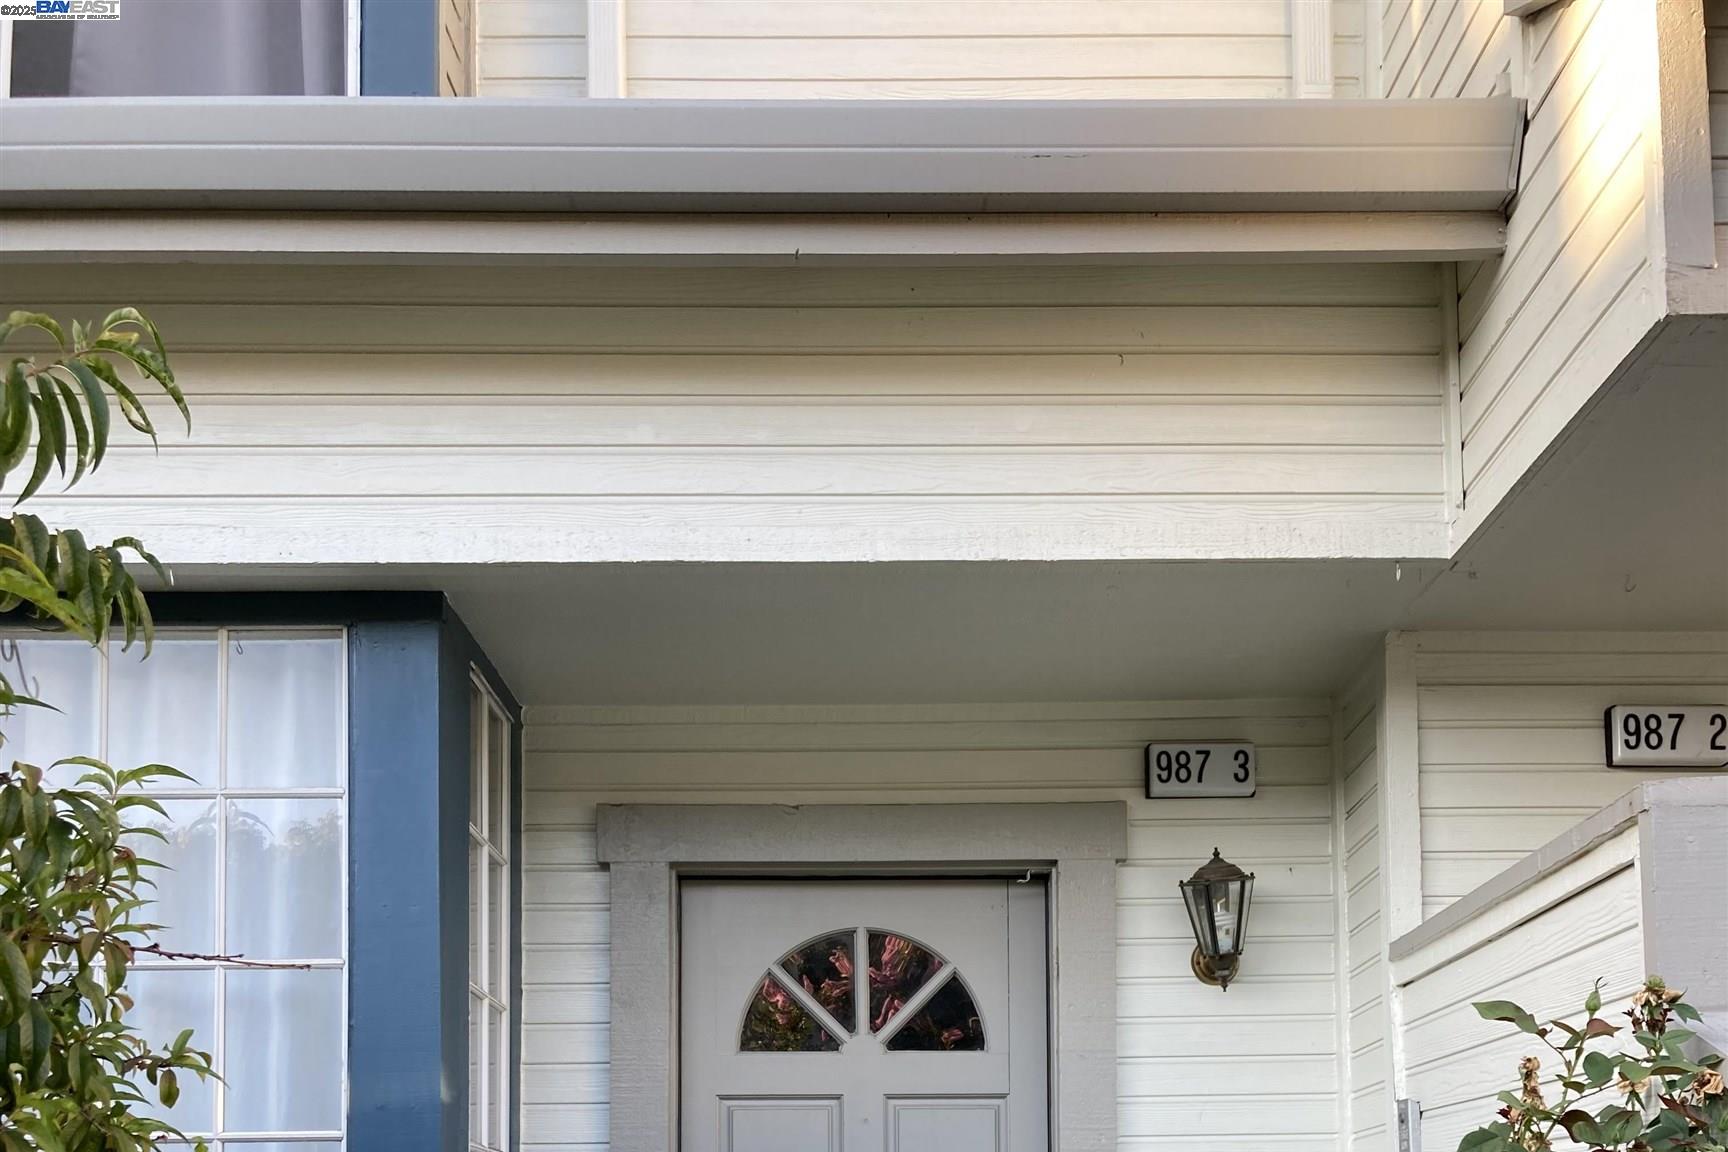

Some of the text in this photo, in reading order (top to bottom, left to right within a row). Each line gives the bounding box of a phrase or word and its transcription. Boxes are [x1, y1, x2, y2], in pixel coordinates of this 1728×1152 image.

[1623, 713, 1727, 751] 987 2
[1156, 749, 1250, 784] 987 3
